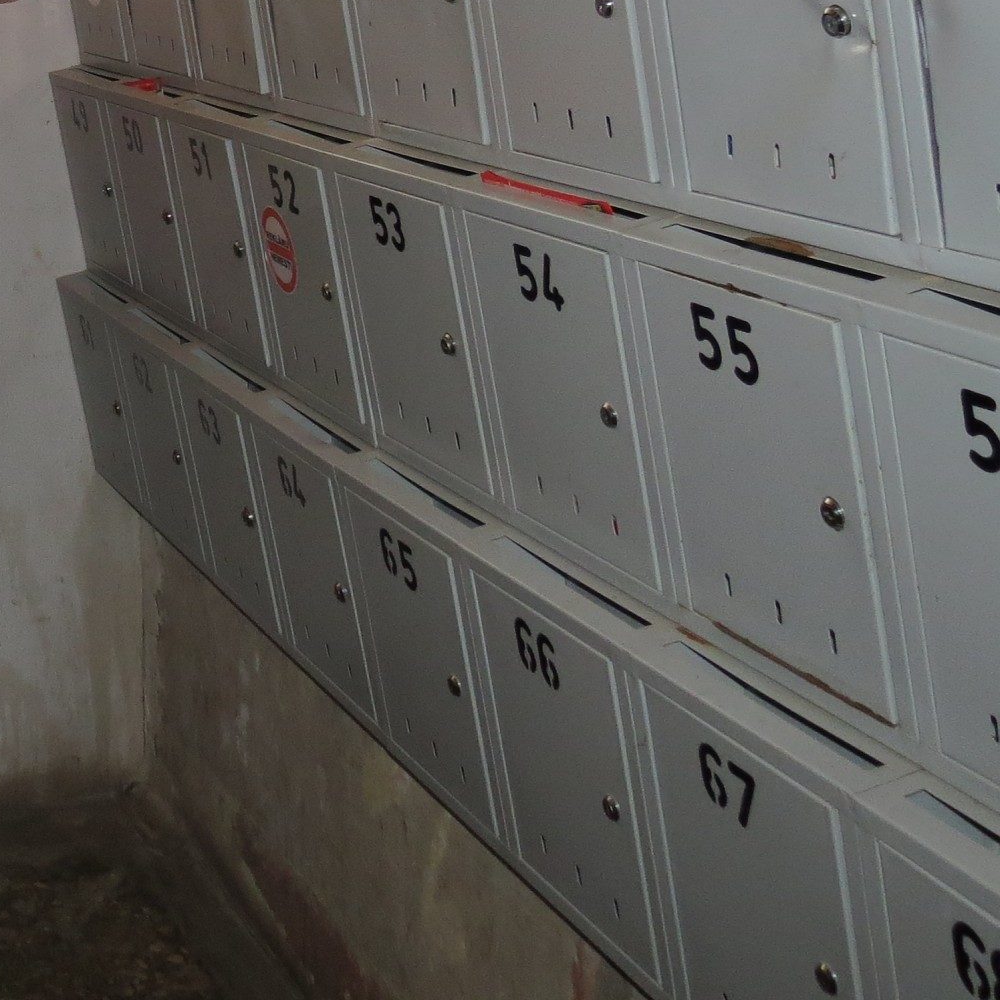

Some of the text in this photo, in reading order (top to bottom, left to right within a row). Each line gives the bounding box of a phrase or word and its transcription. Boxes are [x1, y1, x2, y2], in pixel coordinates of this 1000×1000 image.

[72, 100, 89, 133] 49
[122, 116, 143, 153] 50
[189, 138, 211, 179] 51
[268, 165, 299, 214] 52
[369, 196, 405, 252] 53
[513, 244, 564, 311] 54
[691, 302, 760, 385] 55
[198, 399, 221, 445] 63
[961, 389, 1000, 473] 5
[277, 456, 306, 507] 64
[380, 528, 417, 591] 65
[515, 617, 559, 690] 66
[699, 743, 755, 827] 67
[952, 922, 1000, 1000] 6
